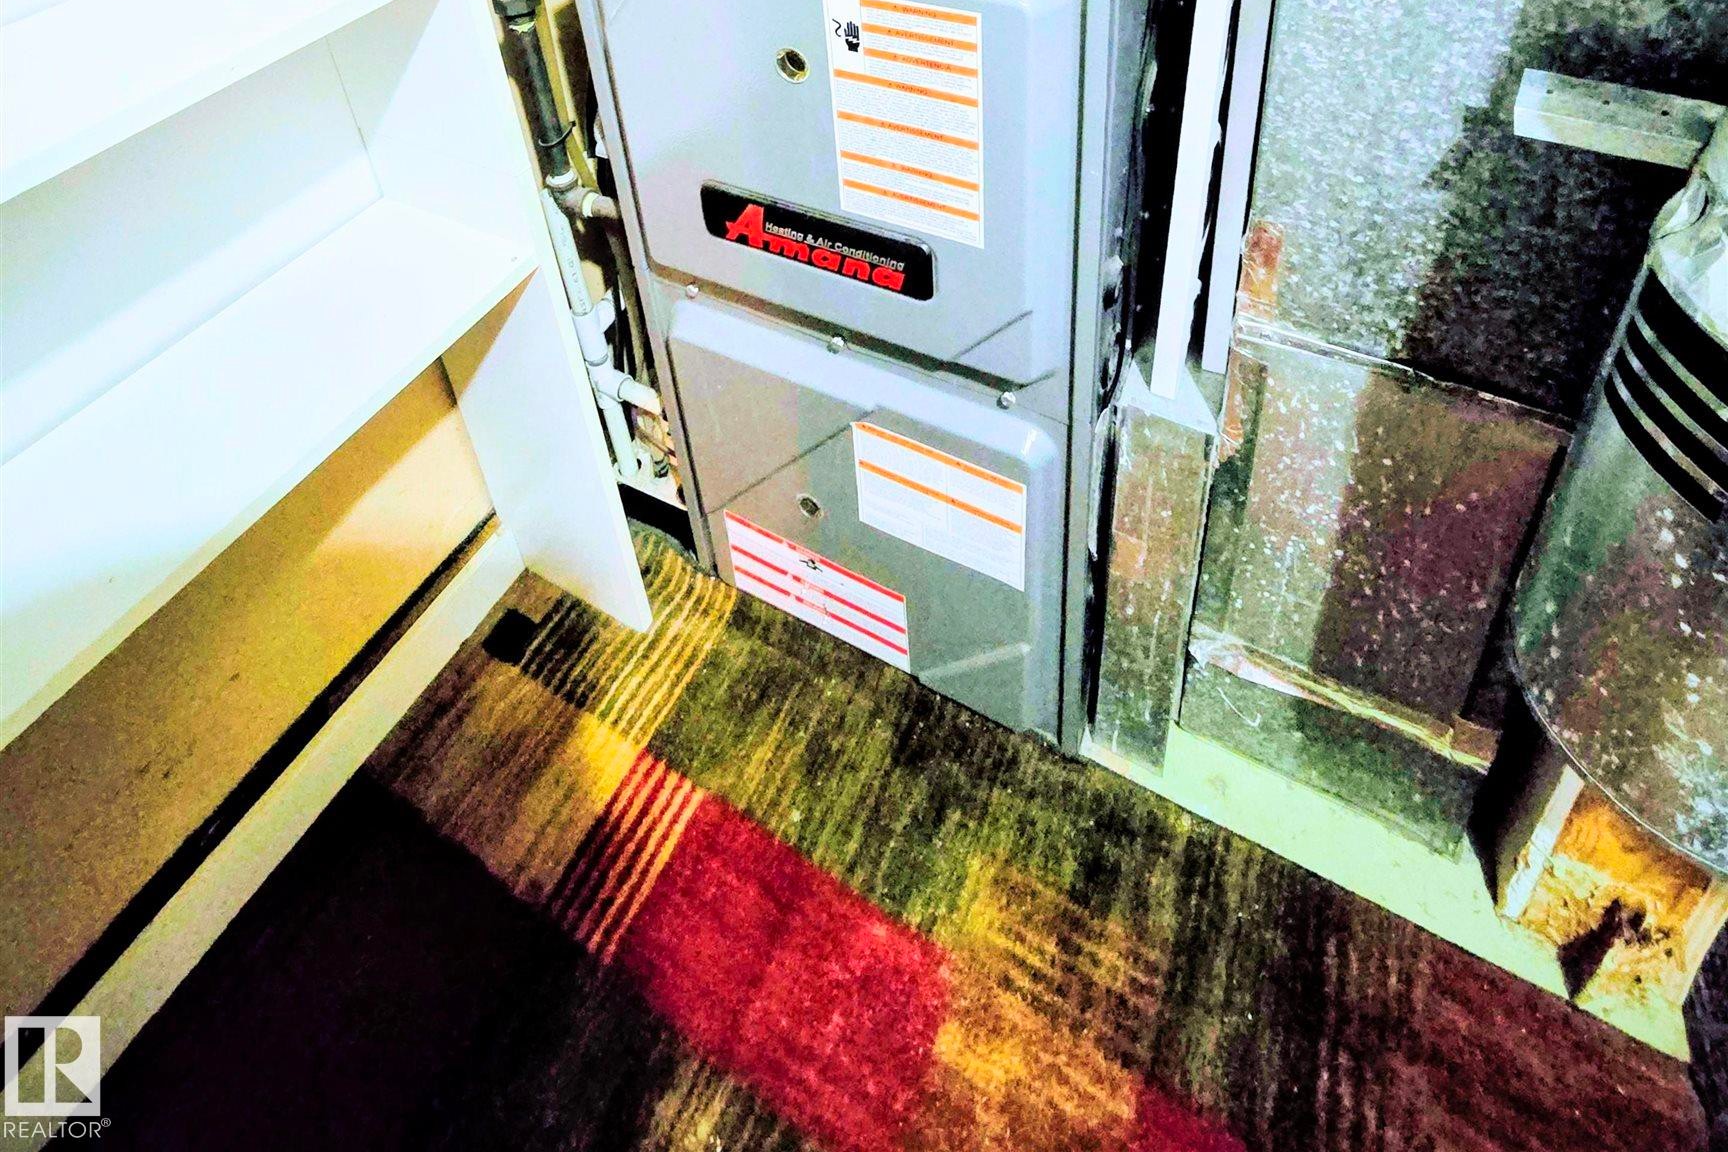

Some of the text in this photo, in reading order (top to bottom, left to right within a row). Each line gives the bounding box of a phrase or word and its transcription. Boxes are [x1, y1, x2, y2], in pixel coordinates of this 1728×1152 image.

[725, 203, 905, 290] Amana
[765, 221, 905, 271] Heating & Air Conditioning
